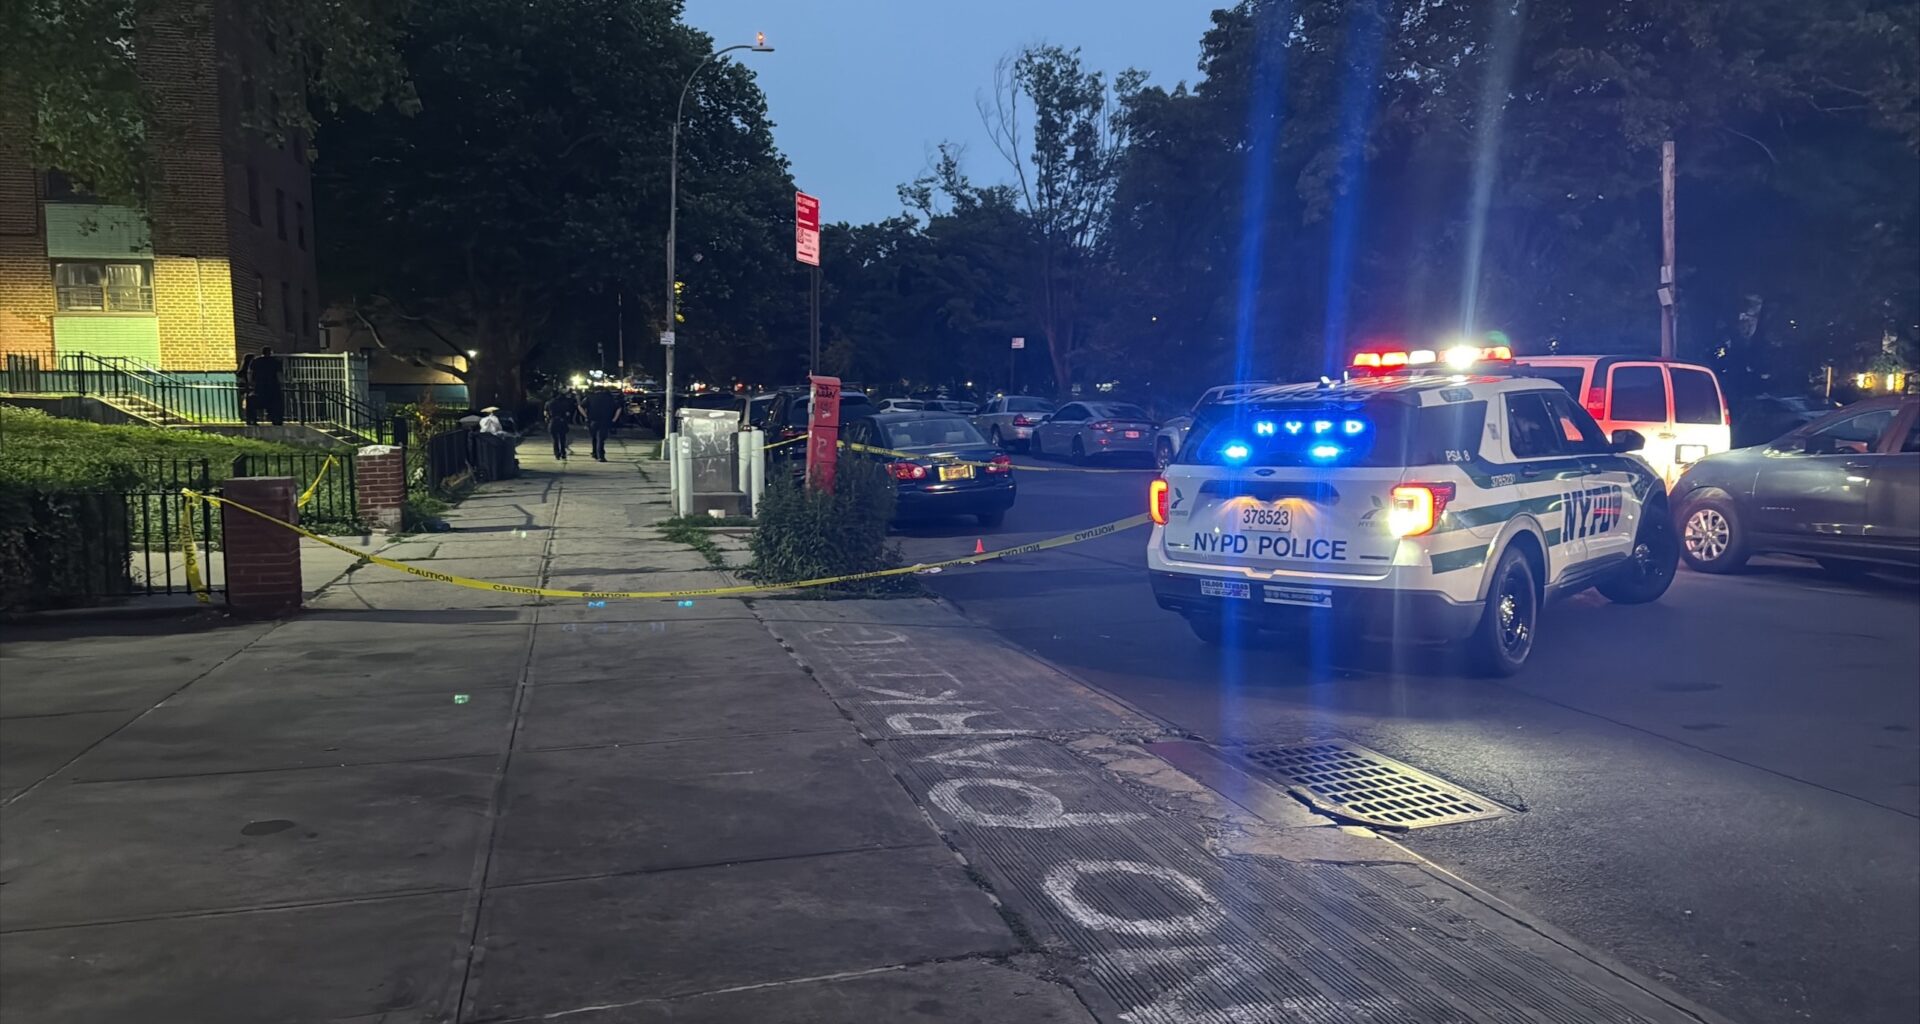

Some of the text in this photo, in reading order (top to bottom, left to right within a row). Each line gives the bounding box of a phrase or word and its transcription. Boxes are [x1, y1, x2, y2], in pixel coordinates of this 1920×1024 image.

[1256, 419, 1364, 434] NYPD
[1242, 508, 1290, 526] 378523
[1562, 485, 1612, 542] NYPD
[1193, 532, 1347, 560] NYPD POLICE
[407, 567, 453, 583] CAUTION
[492, 584, 542, 596] CAUTION
